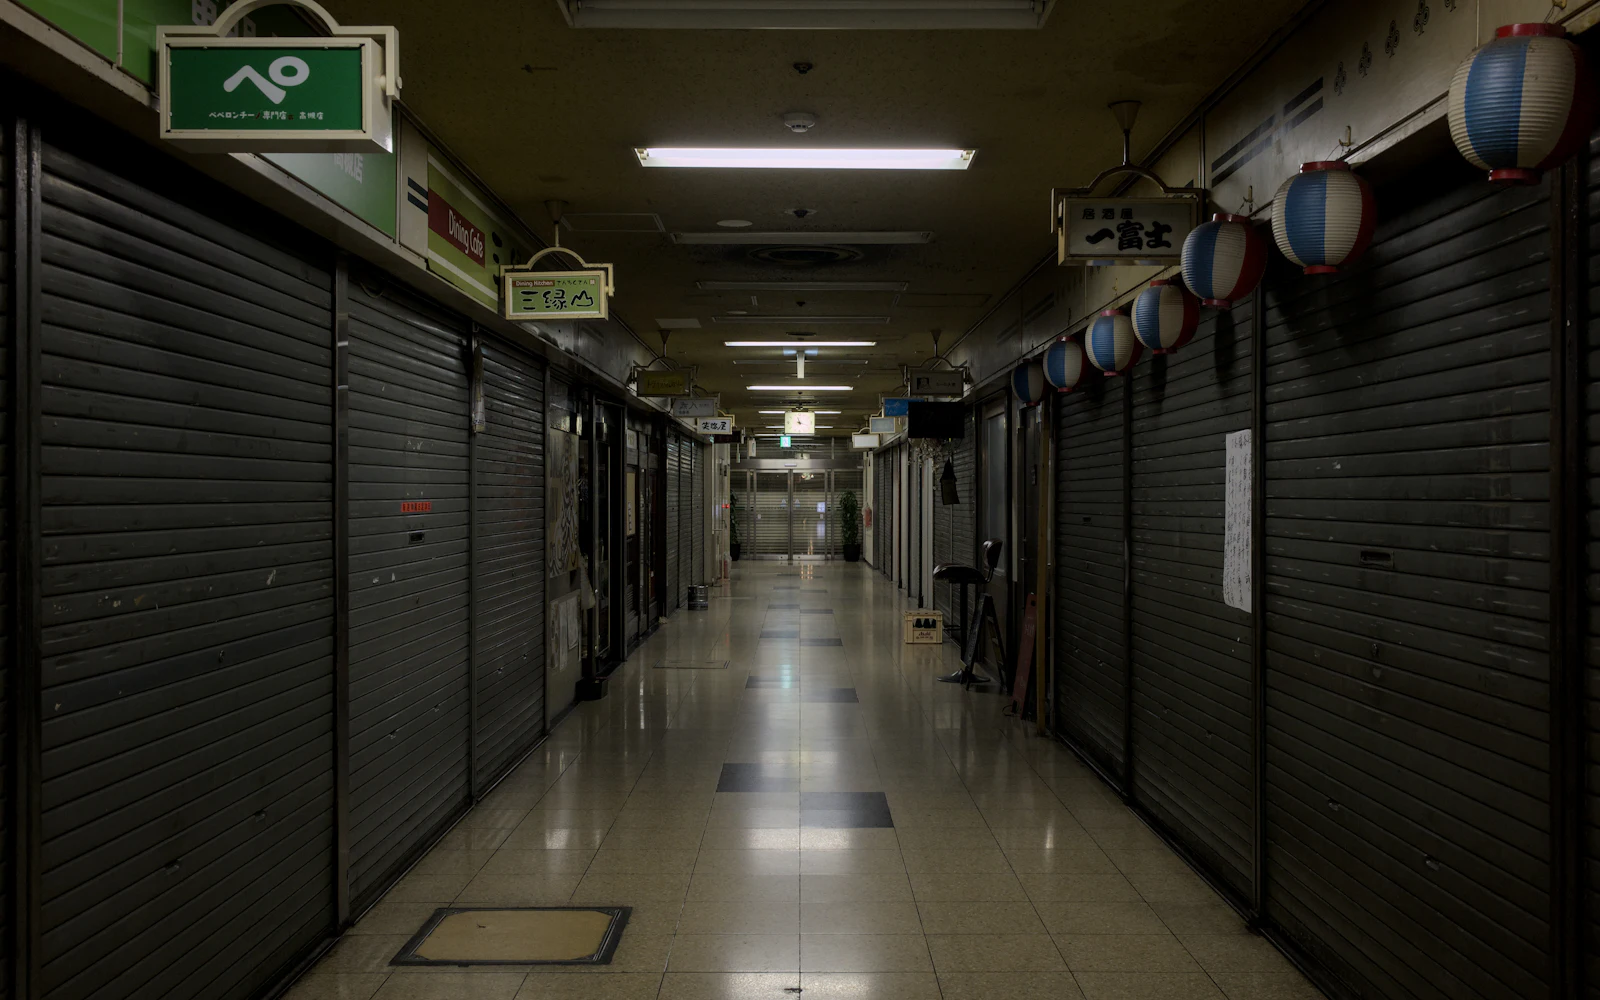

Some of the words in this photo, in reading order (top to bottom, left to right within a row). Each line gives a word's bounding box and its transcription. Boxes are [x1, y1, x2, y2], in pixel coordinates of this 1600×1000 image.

[1082, 208, 1134, 220] 居酒屋
[448, 208, 469, 255] Dining
[1085, 220, 1173, 251] 一富士
[515, 280, 533, 288] Dining
